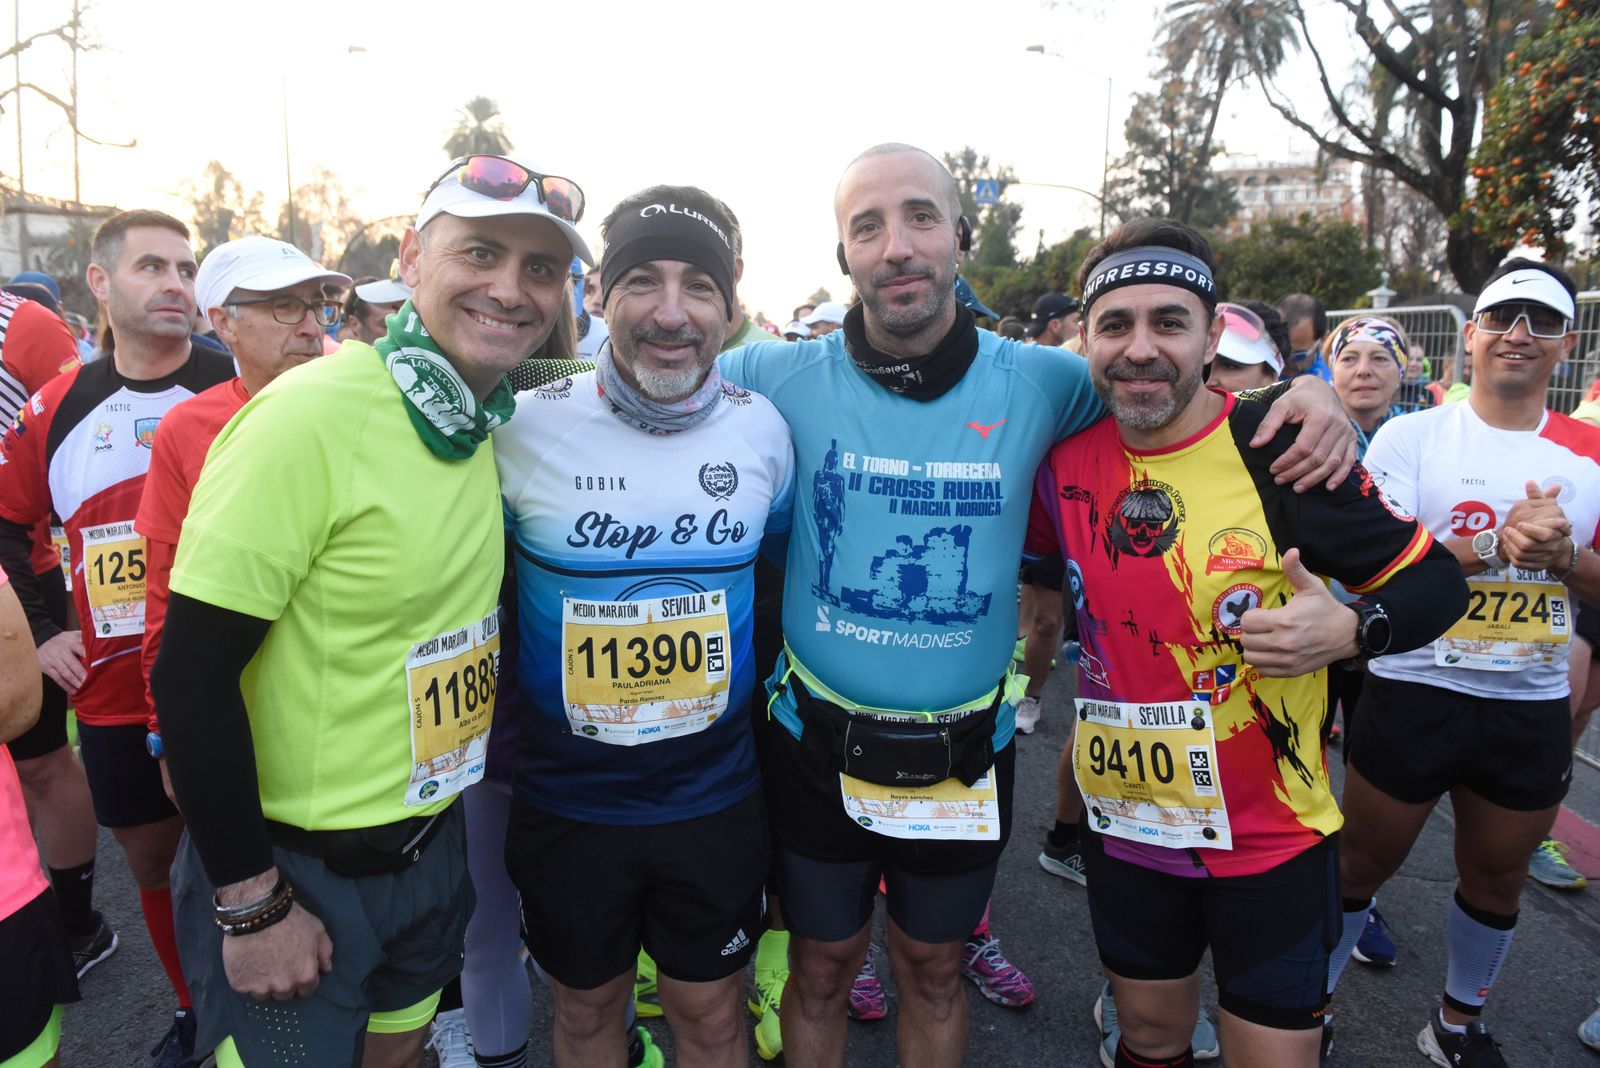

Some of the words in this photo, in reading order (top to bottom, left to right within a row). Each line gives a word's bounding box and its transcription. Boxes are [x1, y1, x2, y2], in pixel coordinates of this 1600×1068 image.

[410, 359, 431, 371] LOS
[105, 403, 131, 413] TACTIC
[843, 452, 856, 470] EL
[862, 455, 909, 476] TORNO
[925, 461, 1002, 480] TORRECERA
[575, 475, 627, 491] GOBIK
[848, 472, 862, 492] II
[868, 475, 936, 499] CROSS
[943, 480, 1004, 501] RURAL
[1461, 478, 1486, 486] TACTIC
[889, 498, 898, 514] II
[901, 499, 951, 517] MARCHA
[955, 500, 1002, 517] NORDICA
[1450, 511, 1490, 530] GO
[88, 526, 105, 540] MEDIO
[106, 524, 133, 538] MARATÓN
[566, 510, 663, 559] Stop
[671, 513, 698, 545] &
[705, 508, 749, 546] Go
[117, 582, 146, 591] ANTONIO
[573, 603, 596, 618] MEDIO
[599, 602, 639, 618] MARATÓN
[661, 594, 706, 618] SEVILLA
[441, 627, 468, 653] MARATÓN
[835, 619, 974, 649] SPORTMADNESS
[577, 630, 703, 680] 11390
[612, 678, 671, 690] PAULADRIANA
[1138, 705, 1187, 726] SEVILLA
[637, 725, 661, 736] HOKA
[1089, 735, 1174, 784] 9410
[908, 824, 931, 832] HOKA
[1138, 826, 1159, 837] HOKA
[721, 938, 750, 956] adidas
